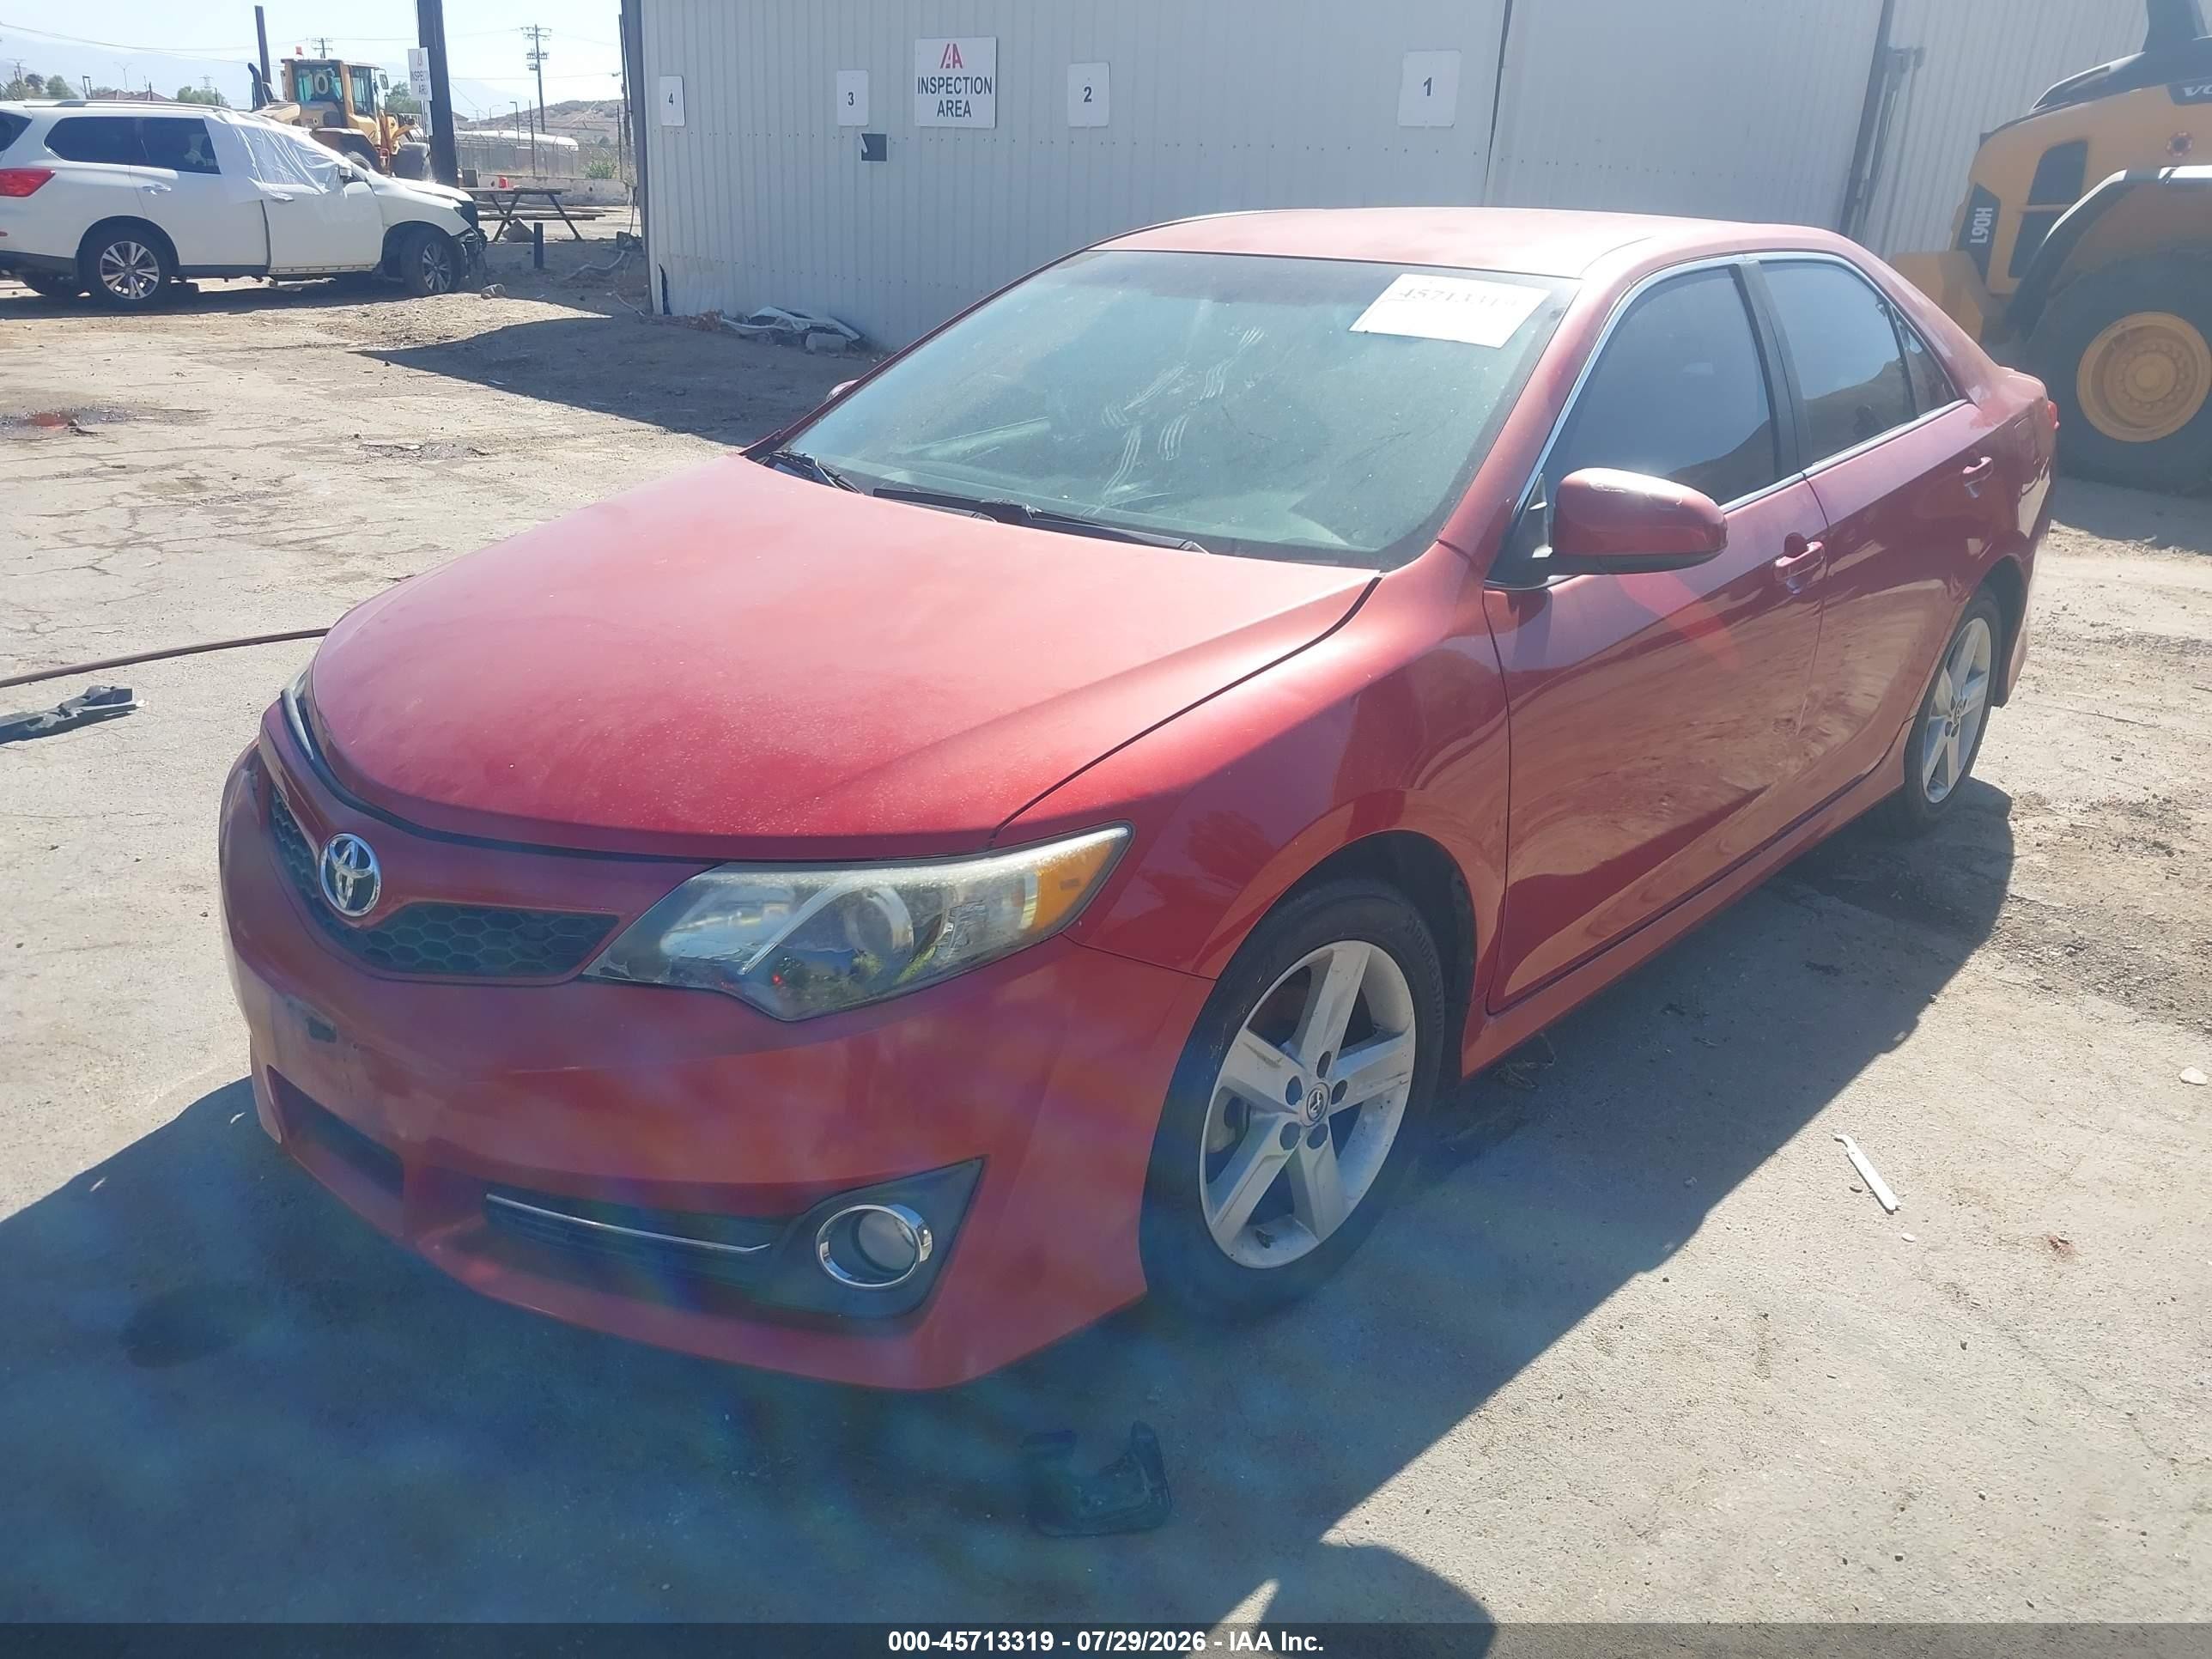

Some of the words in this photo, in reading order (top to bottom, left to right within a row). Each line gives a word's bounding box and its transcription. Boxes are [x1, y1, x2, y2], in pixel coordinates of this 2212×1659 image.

[410, 70, 429, 82] INSPE
[418, 84, 428, 95] AR
[917, 76, 993, 95] INSPECTION
[1084, 86, 1092, 103] 2
[1423, 76, 1432, 96] 1
[668, 92, 674, 106] 4
[848, 91, 854, 106] 3
[936, 99, 972, 118] AREA
[1970, 207, 1993, 244] L90H
[1399, 288, 1518, 307] 45711
